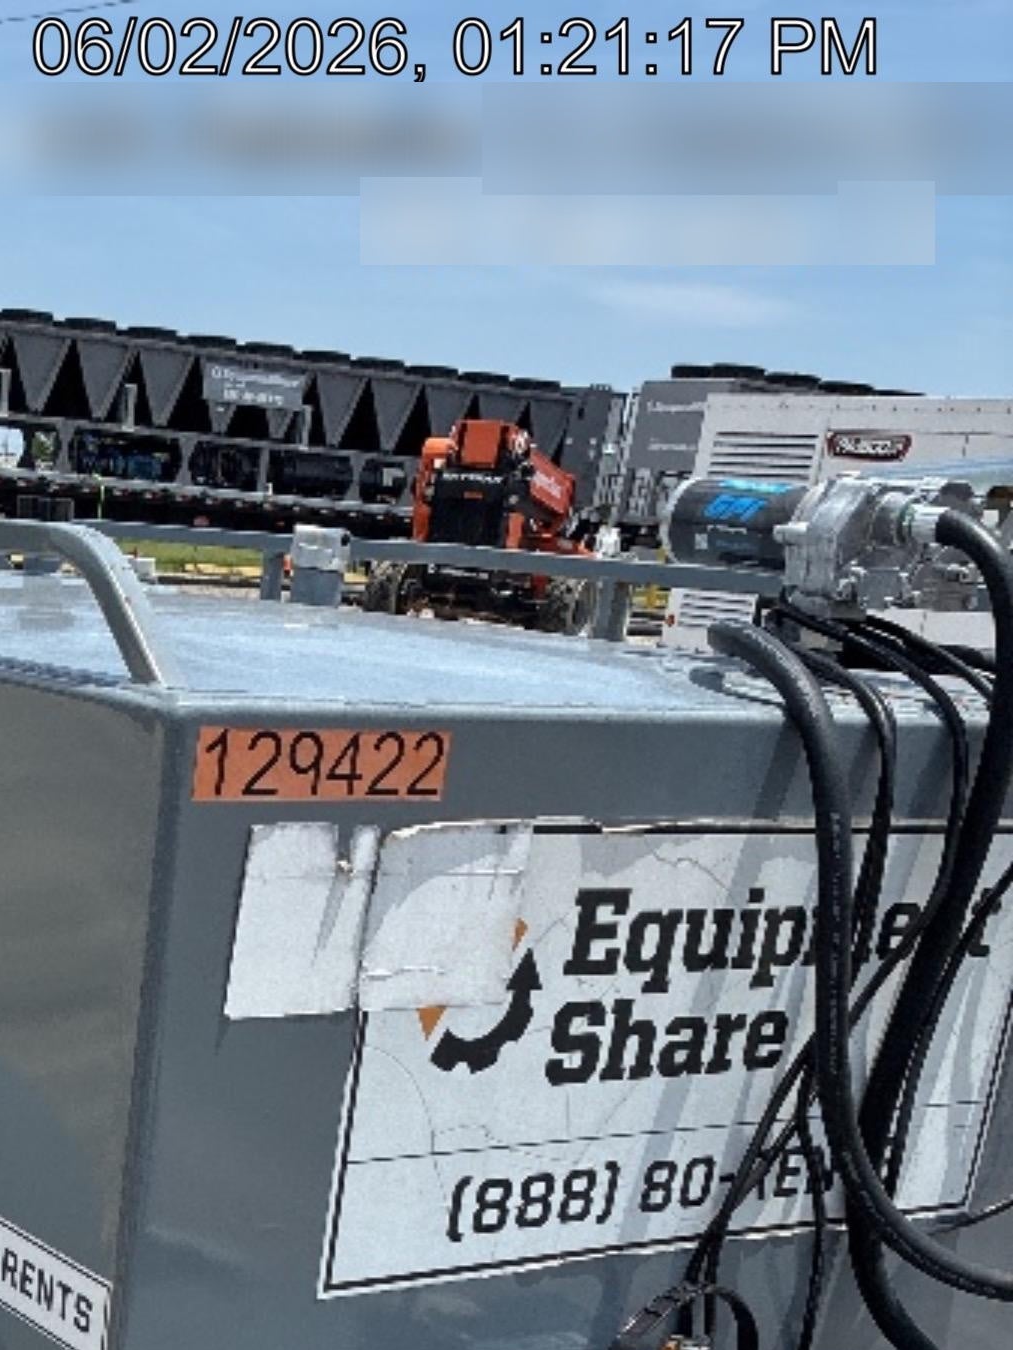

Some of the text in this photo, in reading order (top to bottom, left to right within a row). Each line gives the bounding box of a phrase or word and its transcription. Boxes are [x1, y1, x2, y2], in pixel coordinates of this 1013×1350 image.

[204, 728, 445, 796] 129422
[563, 887, 1002, 994] Equipet
[544, 998, 789, 1087] Share
[446, 1161, 621, 1242] (888)
